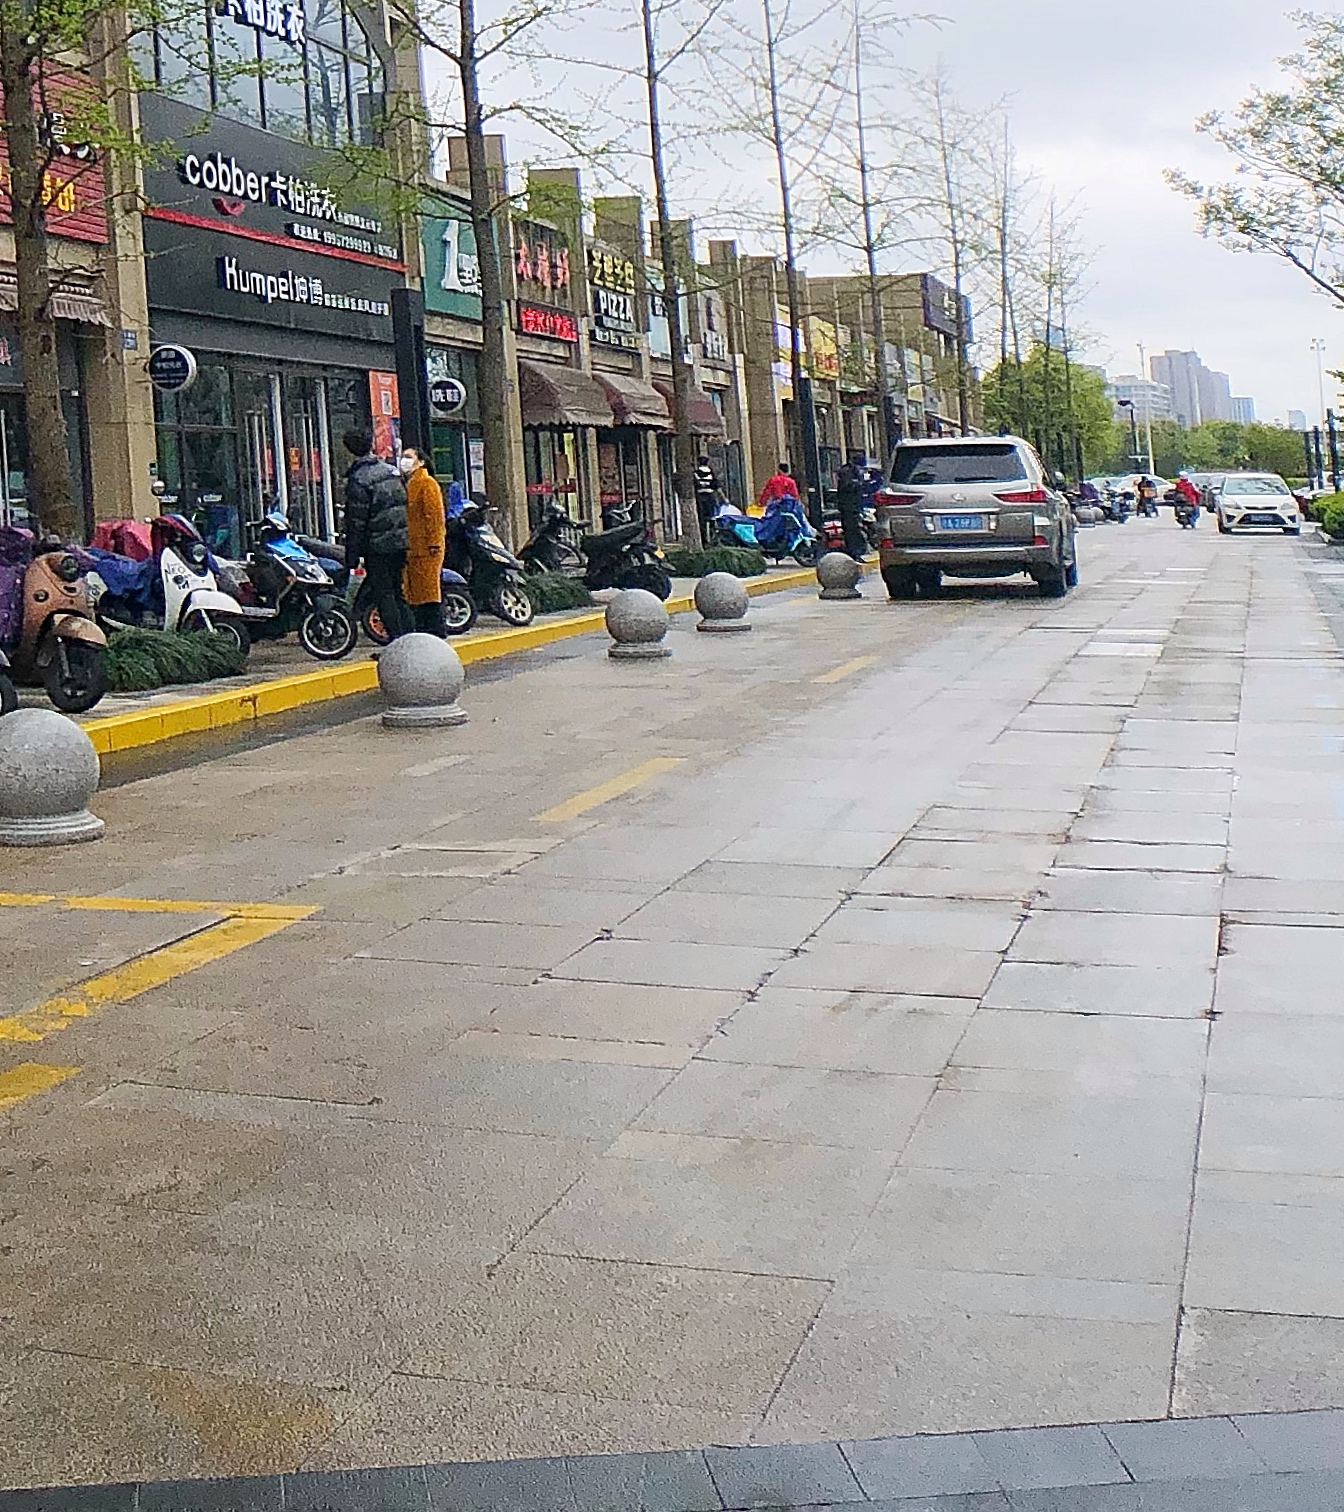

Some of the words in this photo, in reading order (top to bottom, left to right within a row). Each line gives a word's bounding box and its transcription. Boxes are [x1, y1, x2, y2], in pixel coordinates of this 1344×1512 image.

[184, 152, 269, 204] cobber
[224, 255, 293, 304] Kumpel
[599, 288, 634, 323] PIZZA
